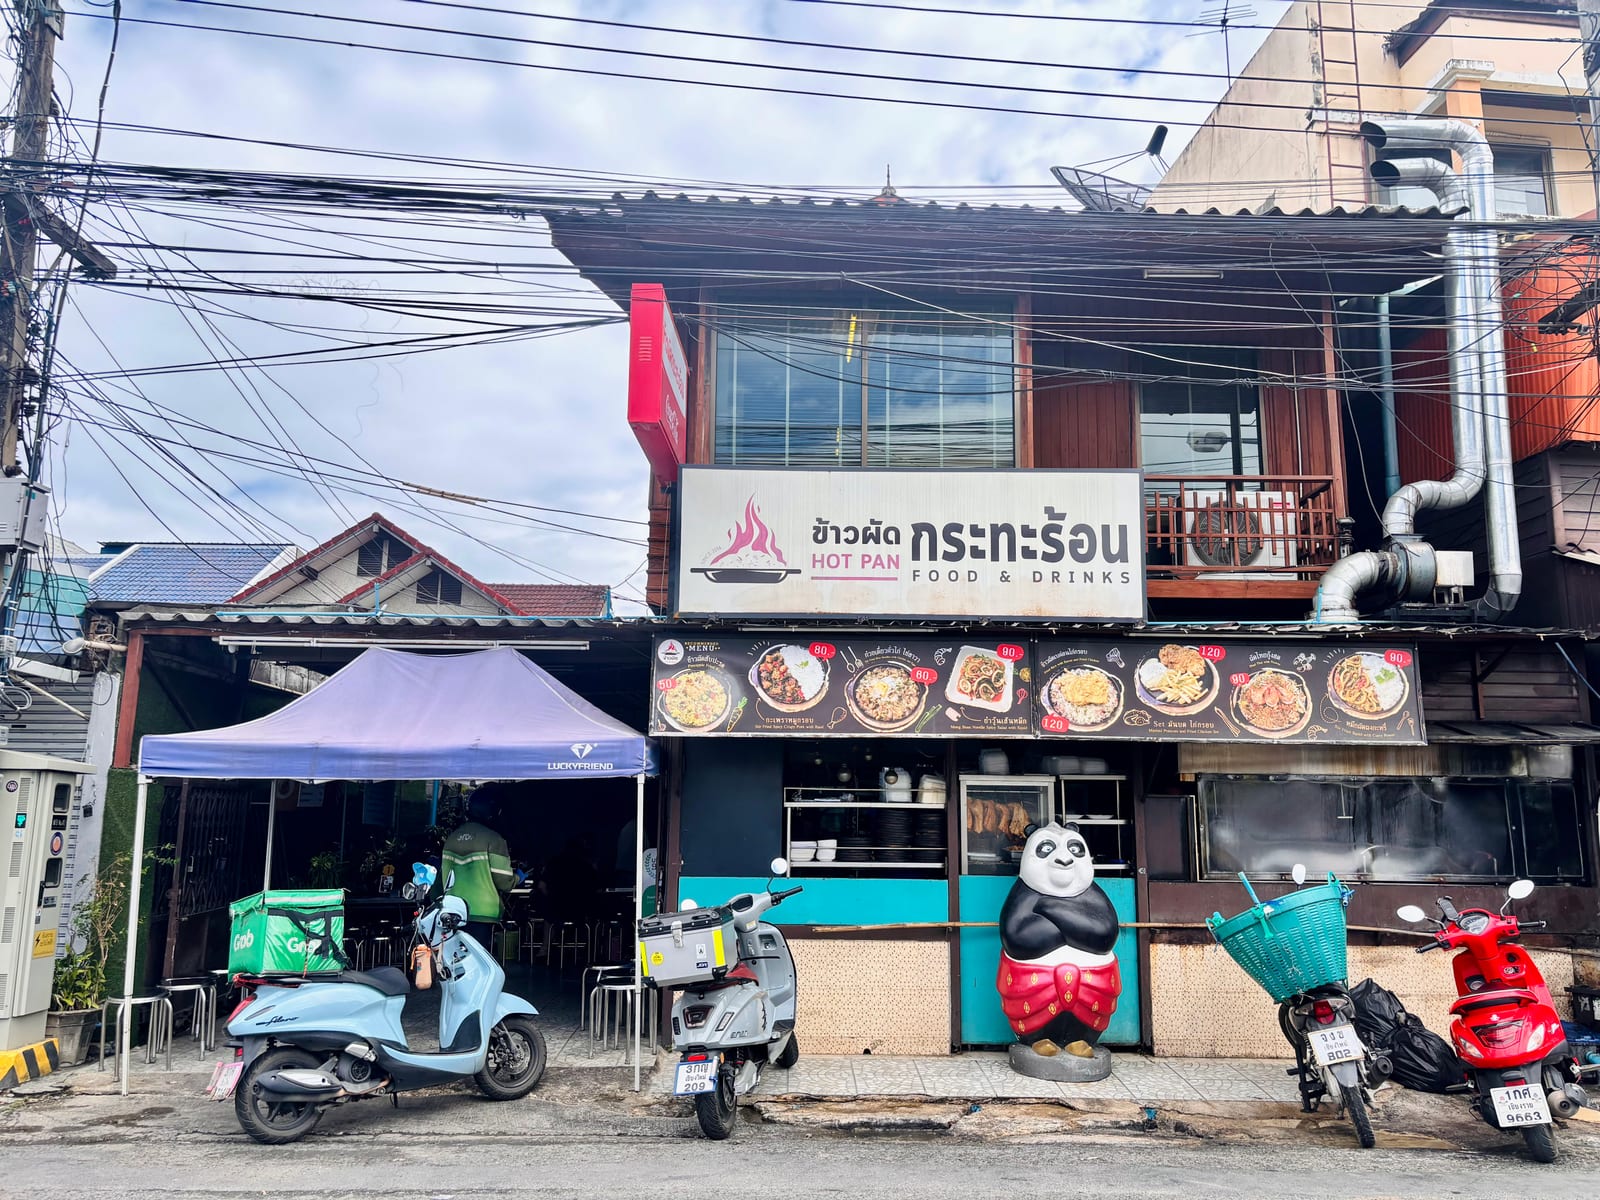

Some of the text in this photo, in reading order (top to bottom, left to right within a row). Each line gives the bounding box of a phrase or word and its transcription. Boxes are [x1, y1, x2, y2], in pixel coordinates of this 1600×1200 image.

[811, 505, 1129, 563] ข้าวผัด กระทะร้อน
[811, 552, 900, 570] HOT PAN
[912, 569, 1130, 584] FOOD & DRINKS
[1201, 646, 1220, 658] 120
[1043, 718, 1063, 730] 120
[1153, 720, 1165, 728] Set
[547, 762, 613, 770] LUCKYFRIEND
[233, 929, 254, 952] Grab
[1327, 1049, 1353, 1061] 802
[684, 1082, 706, 1092] 209
[1506, 1111, 1542, 1123] 9663
